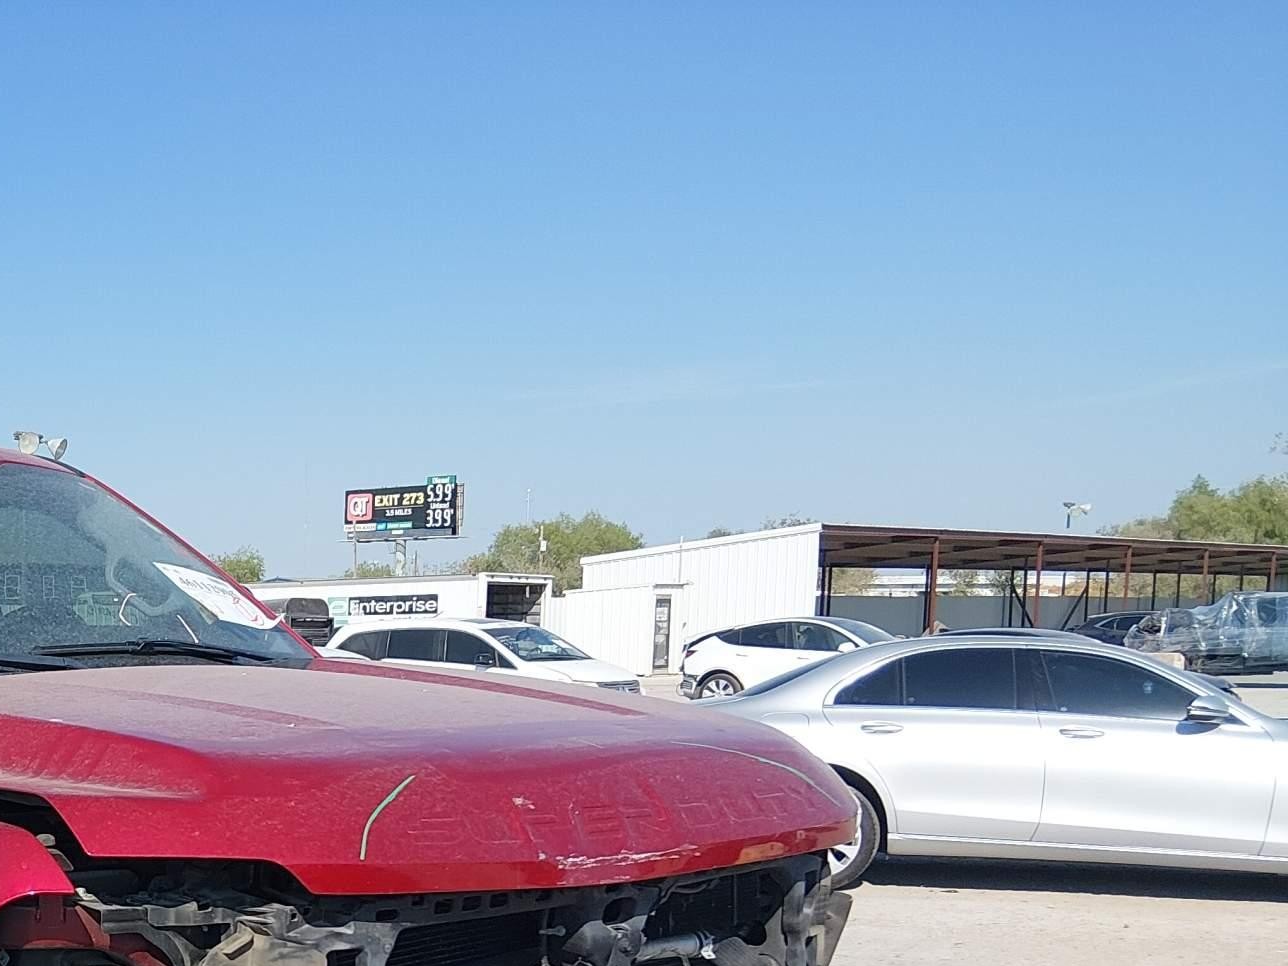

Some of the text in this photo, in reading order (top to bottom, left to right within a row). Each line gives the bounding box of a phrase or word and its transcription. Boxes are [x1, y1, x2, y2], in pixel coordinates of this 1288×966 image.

[349, 496, 369, 518] QT
[374, 494, 400, 507] EXIT
[402, 492, 425, 506] 273
